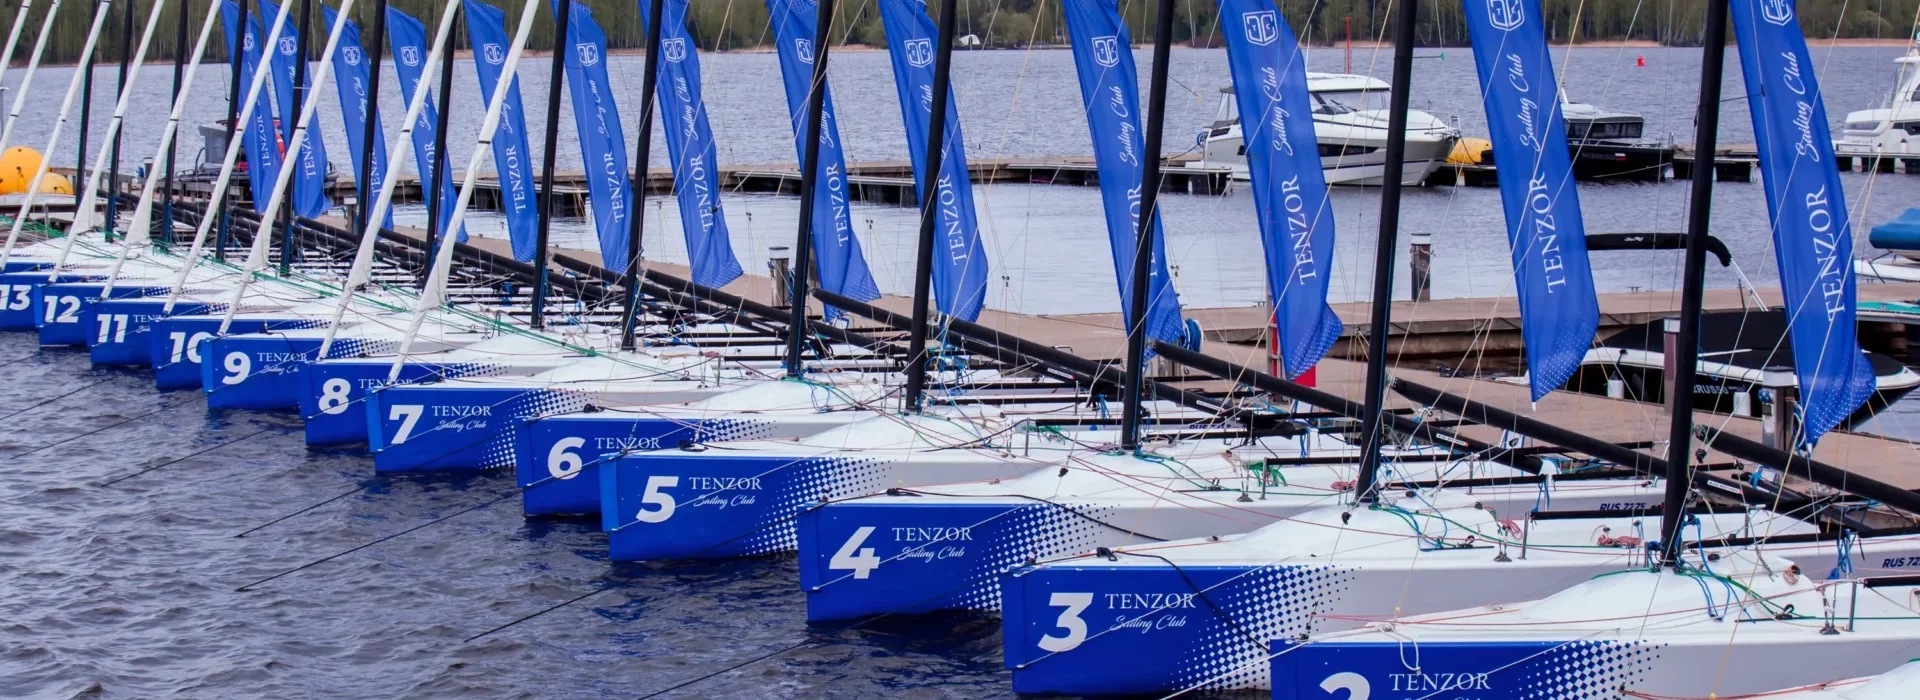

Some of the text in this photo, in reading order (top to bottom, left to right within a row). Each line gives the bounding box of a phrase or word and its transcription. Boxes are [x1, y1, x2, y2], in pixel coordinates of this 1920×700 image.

[676, 76, 699, 140] Sailing Club
[1261, 66, 1294, 156] Sailing Club
[1509, 53, 1541, 152] Sailing Club
[1782, 51, 1820, 162] Sailing Club
[1110, 85, 1138, 166] Sailing Club
[301, 130, 317, 179] TENZO
[506, 145, 526, 213] TENZOR
[604, 150, 625, 223] TENZOR
[691, 152, 714, 232] TENZOR
[826, 162, 849, 247] TENZOR
[939, 173, 967, 265] TENZOR
[1281, 174, 1316, 285] TENZOR
[1529, 171, 1566, 293] TENZOR
[1806, 184, 1845, 323] TENZOR
[0, 284, 32, 310] 13
[44, 295, 81, 323] 12
[97, 314, 129, 343] 11
[222, 352, 251, 384] 9
[257, 352, 308, 362] TENZOR
[318, 378, 351, 414] 8
[431, 405, 492, 416] TENZOR
[389, 405, 424, 444] 7
[436, 419, 487, 432] Sailing Club
[594, 437, 661, 449] TENZOR
[547, 436, 586, 480] 6
[635, 475, 679, 523] 5
[689, 477, 763, 490] TENZOR
[693, 494, 756, 509] Sailing Club
[829, 526, 881, 579] 4
[892, 527, 973, 541] TENZOR
[896, 546, 965, 563] Sailing Club
[1881, 556, 1920, 569] RUS 72
[1105, 593, 1196, 609] TENZOR
[1037, 592, 1094, 652] 3
[1109, 614, 1187, 634] Sailing Club
[1389, 672, 1492, 691] TENZOR
